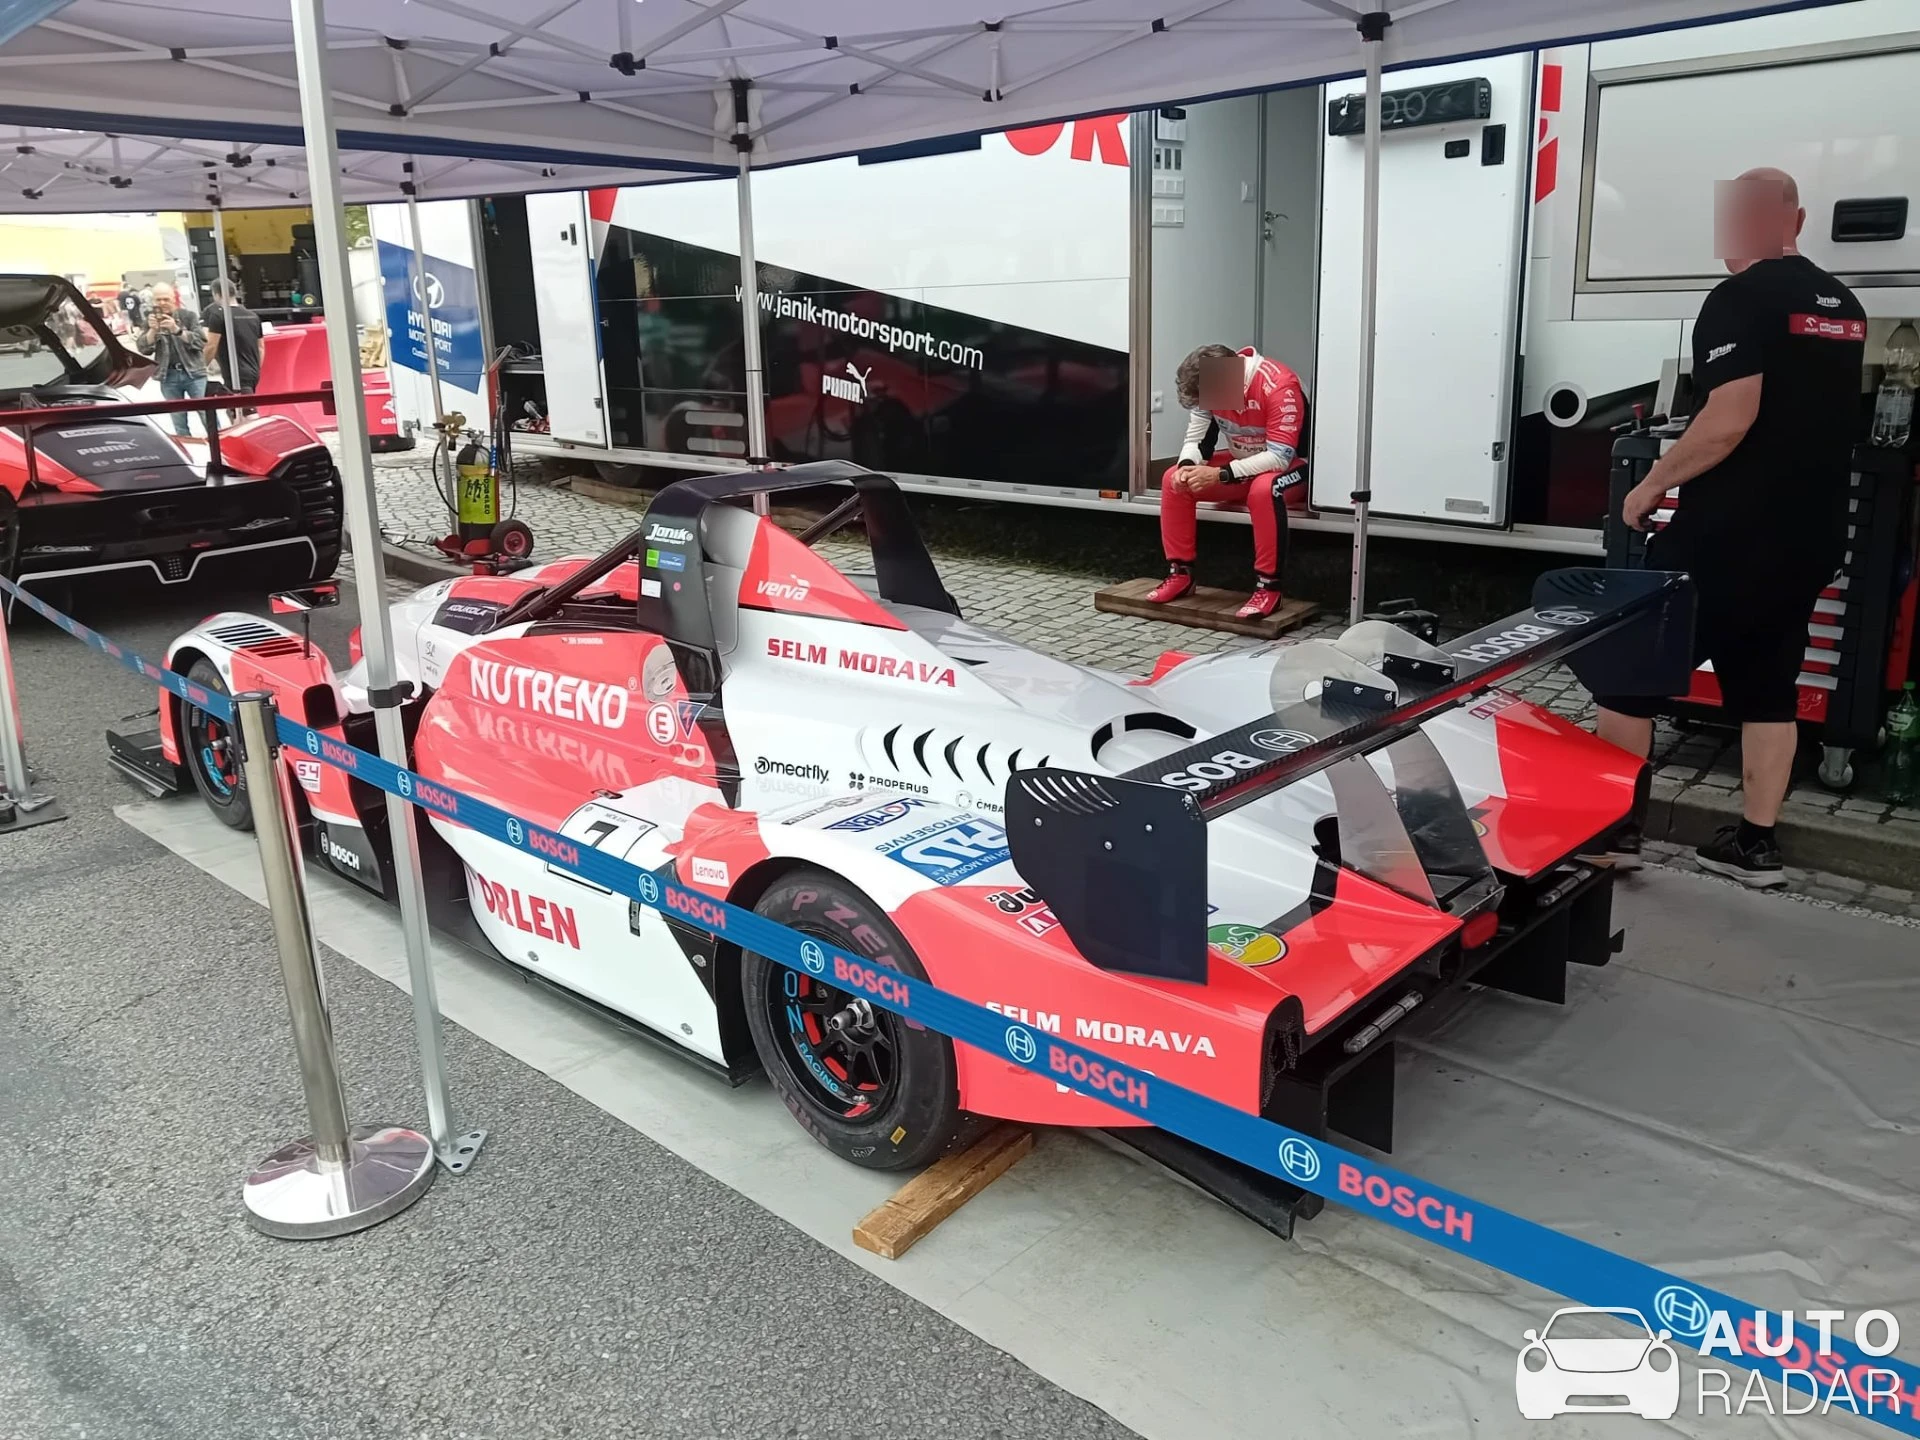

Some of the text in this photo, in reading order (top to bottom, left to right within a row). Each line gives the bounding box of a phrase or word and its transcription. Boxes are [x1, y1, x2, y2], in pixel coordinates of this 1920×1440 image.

[408, 328, 452, 353] MOTPORT
[822, 374, 864, 404] PUMA
[756, 577, 810, 601] verva
[767, 637, 956, 688] SELM MORAVA
[1452, 622, 1558, 664] BOSCH
[470, 657, 629, 729] NUTREND
[321, 741, 357, 769] BOSCH
[415, 781, 458, 814] BOSCH
[869, 776, 929, 795] PROPERUS
[528, 829, 579, 867] BOSCH
[874, 812, 973, 853] AUTOSERVIS
[329, 841, 360, 870] BOSCH
[694, 865, 726, 881] Lenovo
[477, 872, 580, 950] ORLEN
[664, 886, 727, 930] BOSCH
[833, 955, 910, 1009] BOSCH
[1076, 1018, 1217, 1058] MORAVA
[799, 1043, 840, 1093] RACING
[1049, 1045, 1148, 1109] BOSCH
[1337, 1162, 1474, 1243] BOSCH
